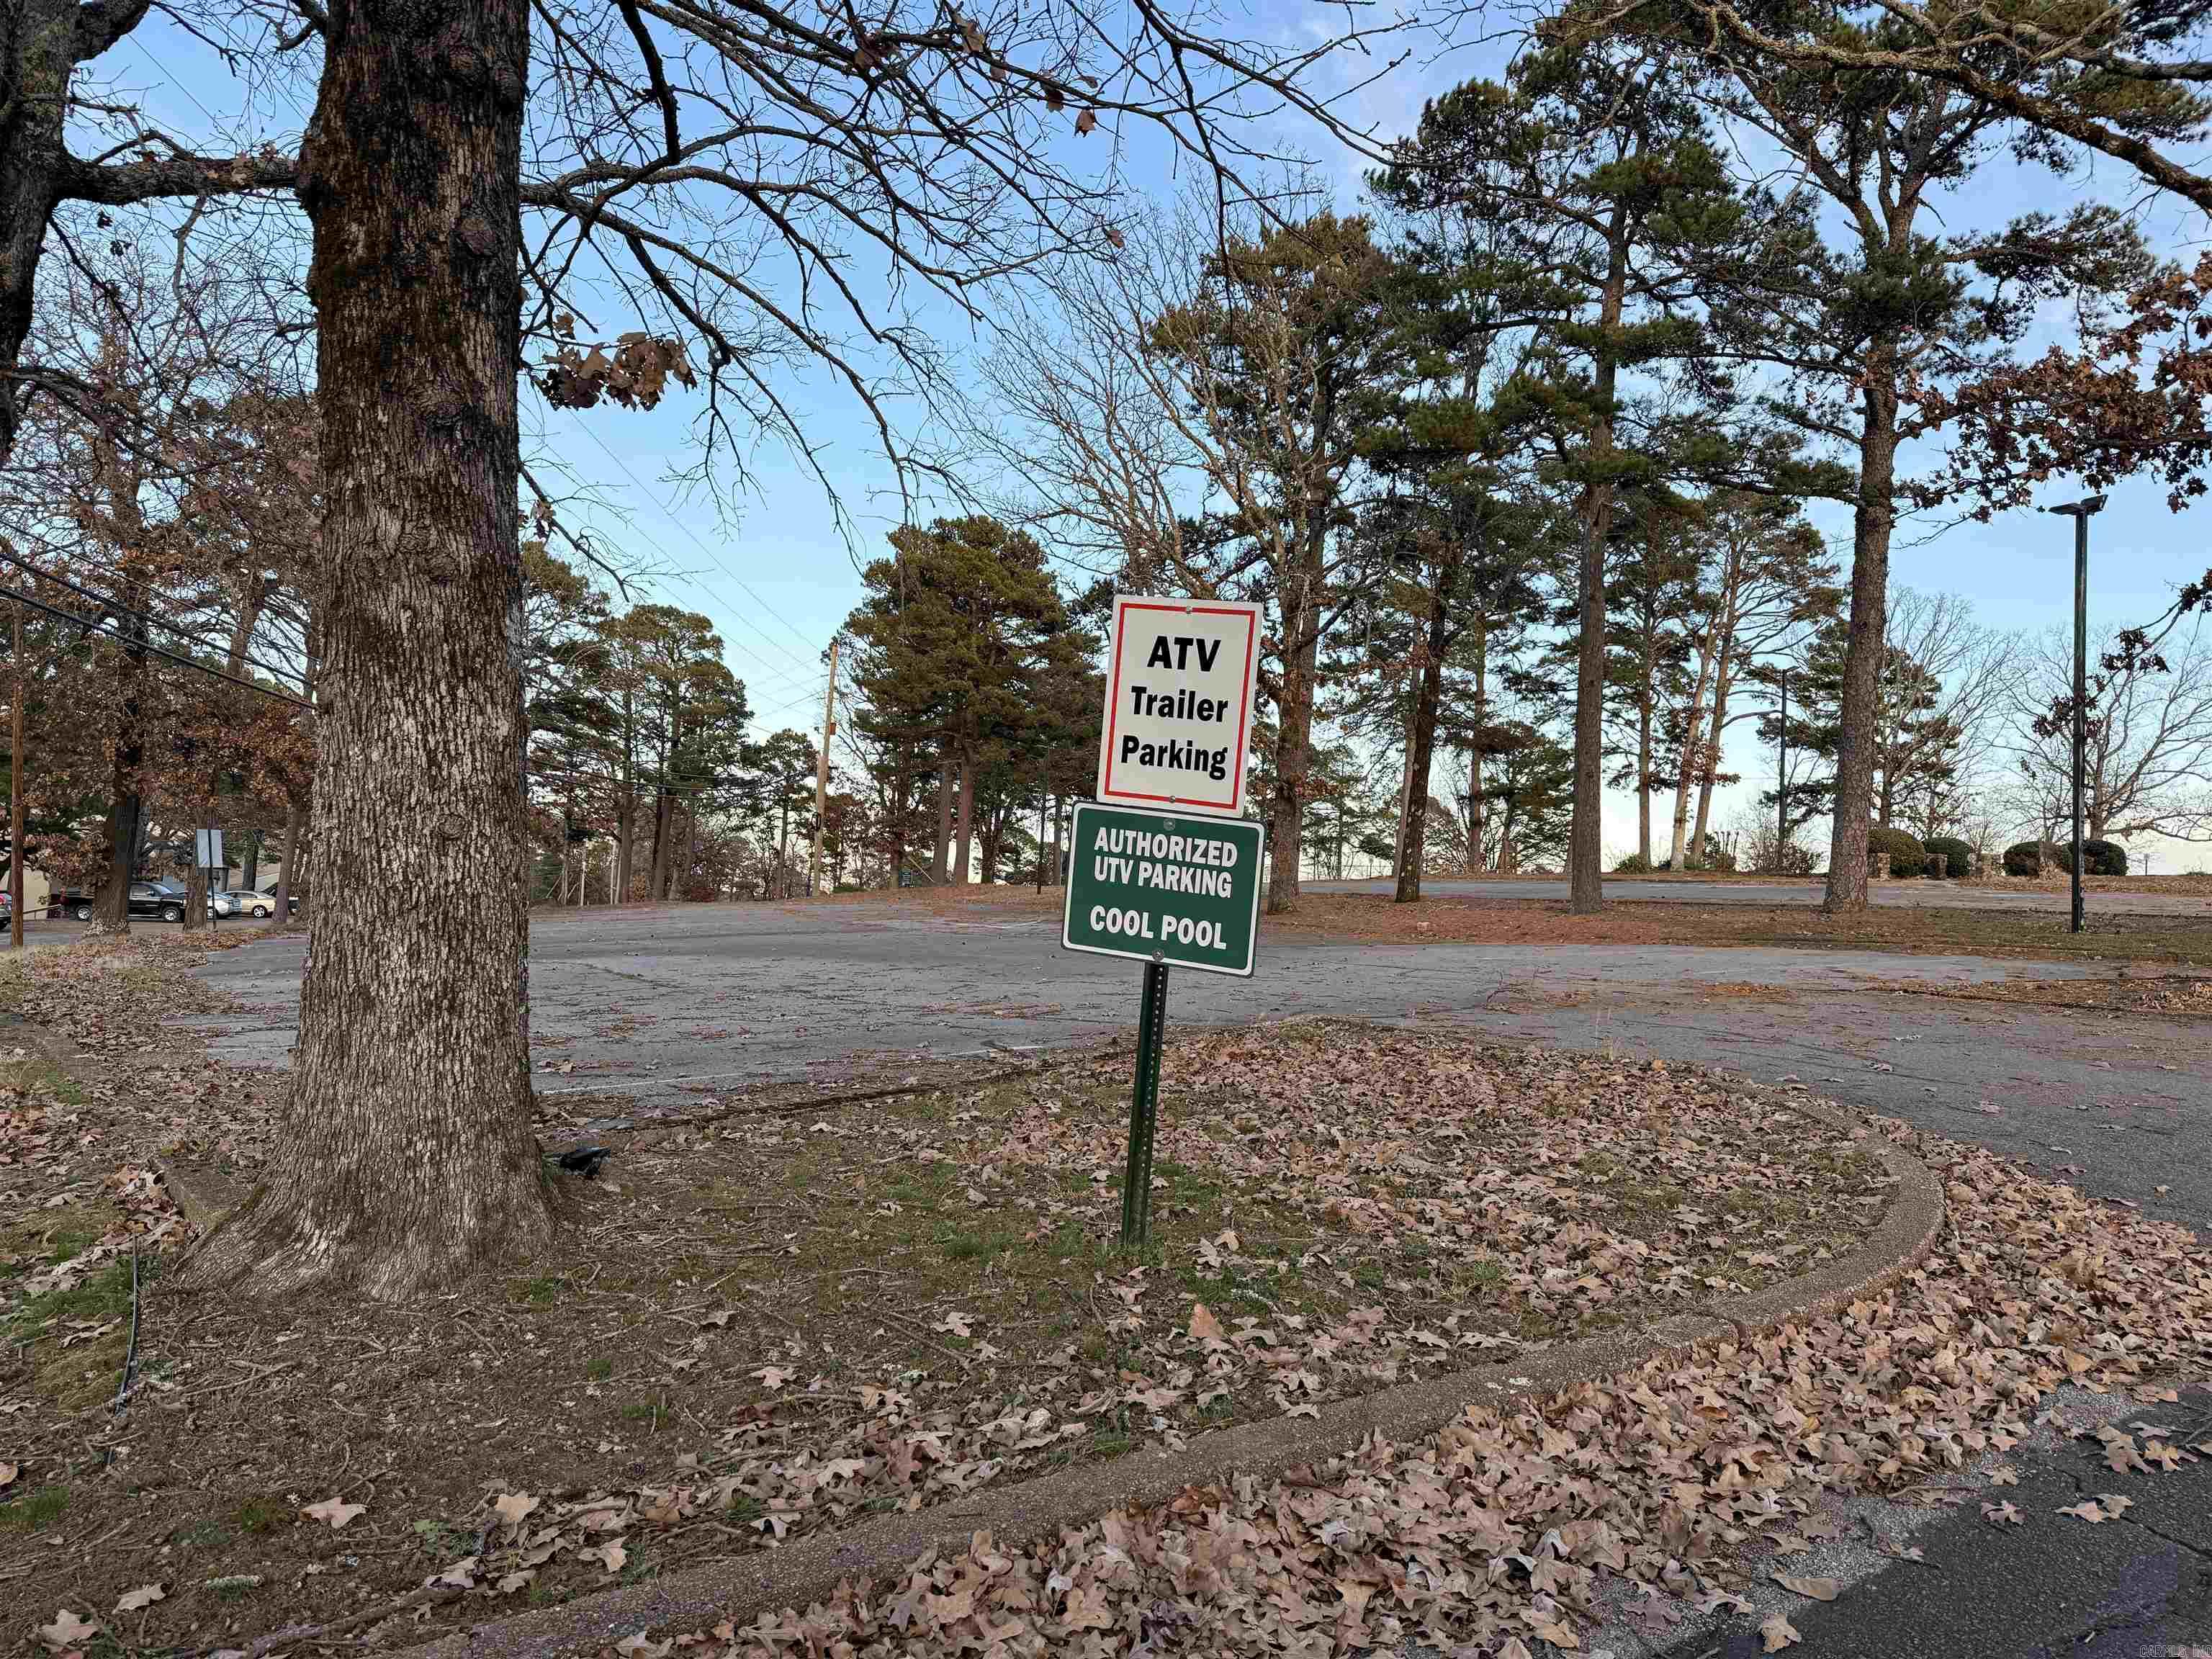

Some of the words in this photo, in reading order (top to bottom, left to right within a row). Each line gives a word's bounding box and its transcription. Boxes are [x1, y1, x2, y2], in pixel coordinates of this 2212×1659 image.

[1147, 635, 1221, 673] ATV
[1130, 685, 1228, 722] Trailer
[1120, 735, 1228, 781] Parking
[1094, 827, 1238, 867] AUTHORIZED
[1094, 855, 1133, 884] UTV
[1138, 861, 1233, 899] PARKING
[1089, 904, 1154, 939] COOL
[1161, 914, 1227, 950] POOL
